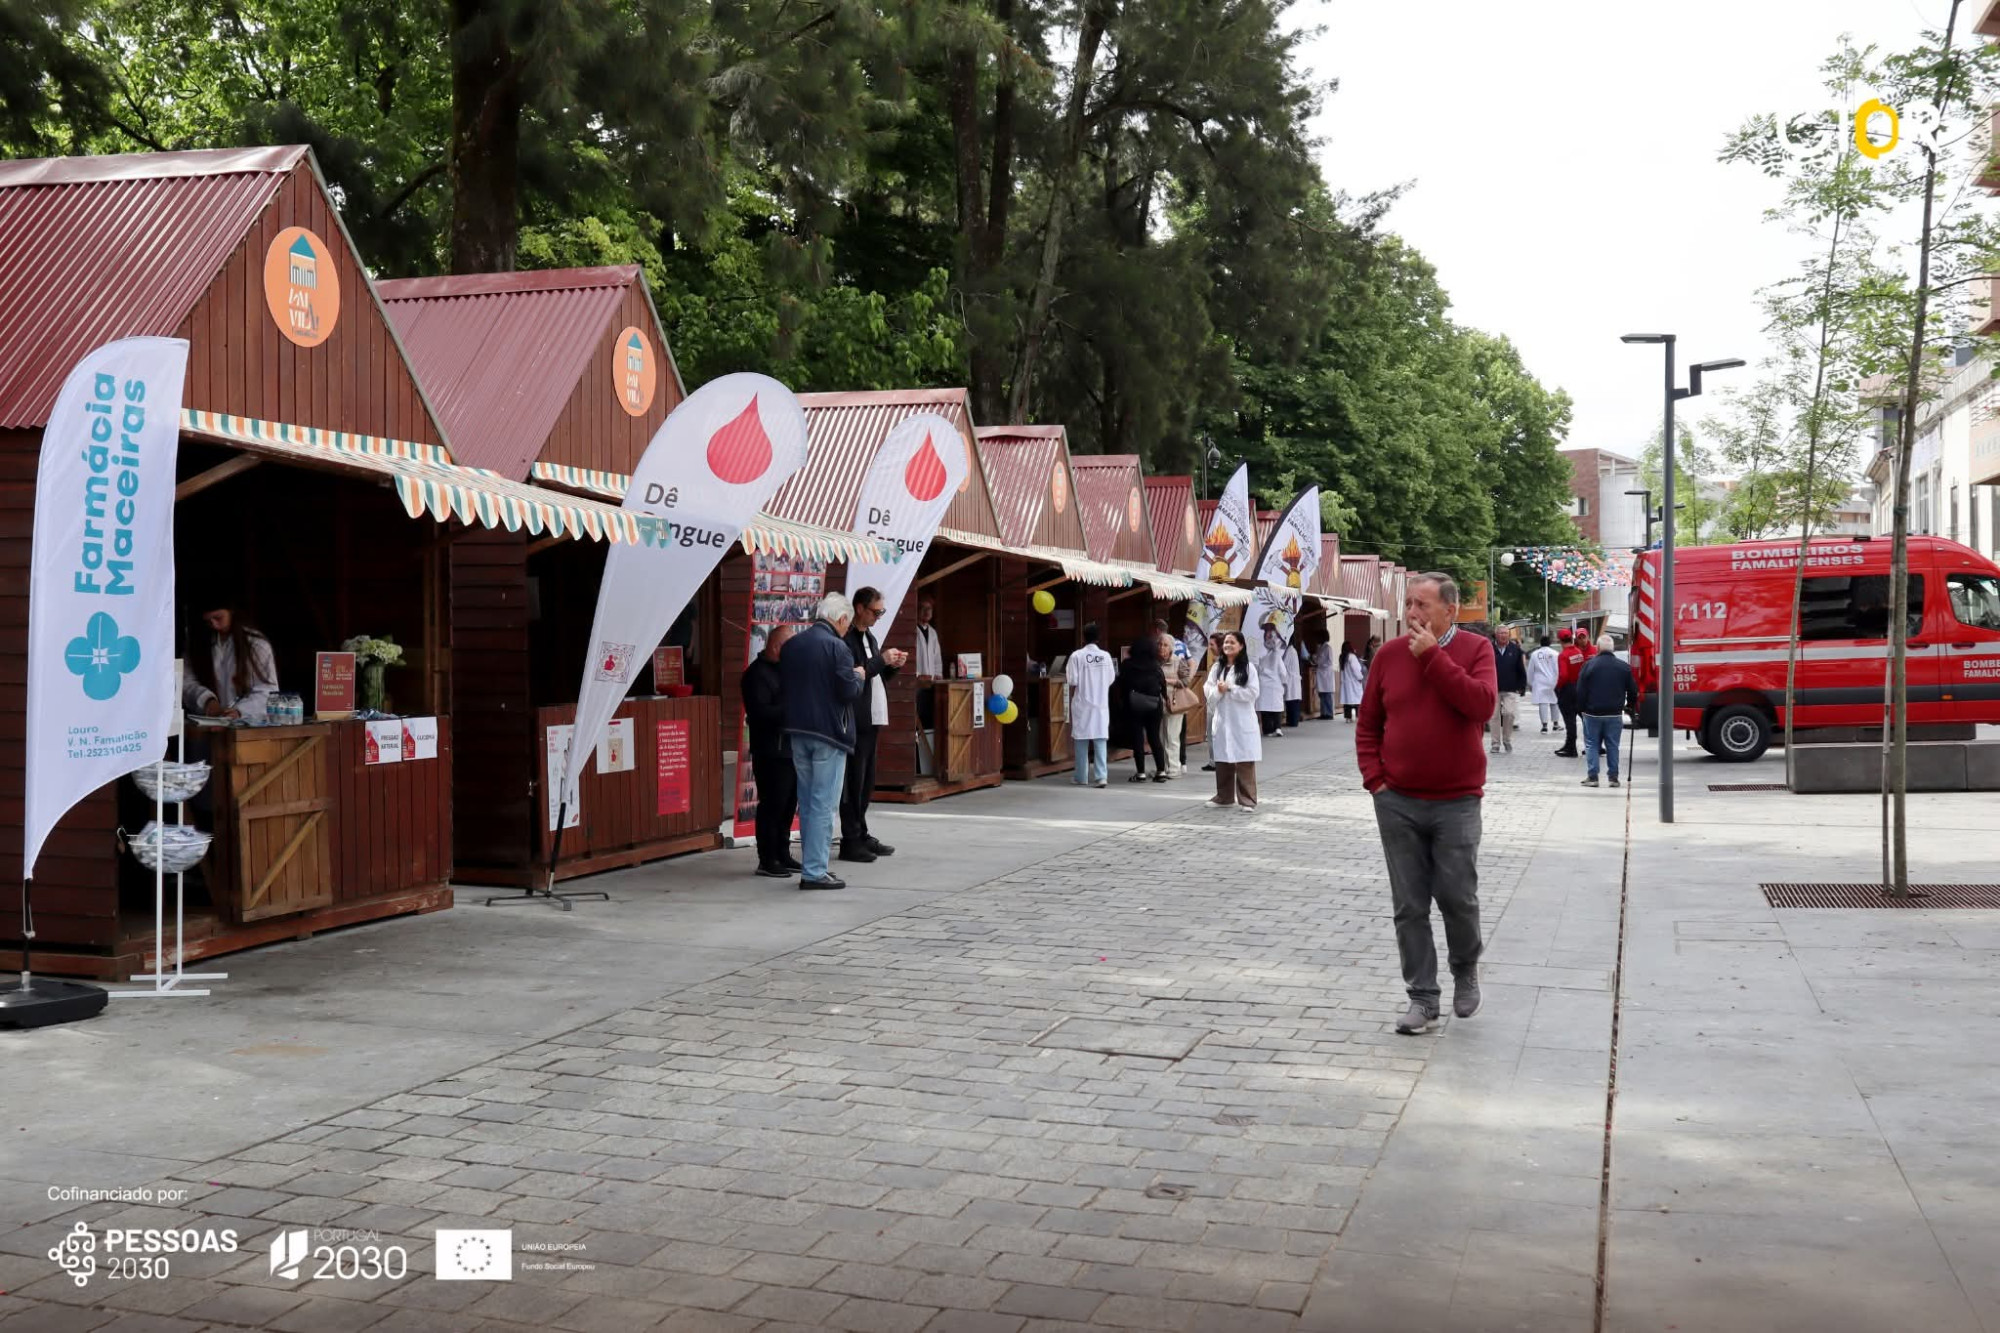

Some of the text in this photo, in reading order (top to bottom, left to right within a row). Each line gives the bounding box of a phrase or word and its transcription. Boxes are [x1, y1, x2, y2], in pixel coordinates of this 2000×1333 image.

[74, 372, 116, 594] Farmácia
[104, 378, 147, 595] Maceiras
[644, 482, 679, 509] Dê
[868, 507, 891, 526] Dê
[1688, 602, 1727, 620] 112
[1678, 682, 1690, 691] 01
[68, 726, 99, 735] Louro
[94, 730, 148, 745] Famalicão
